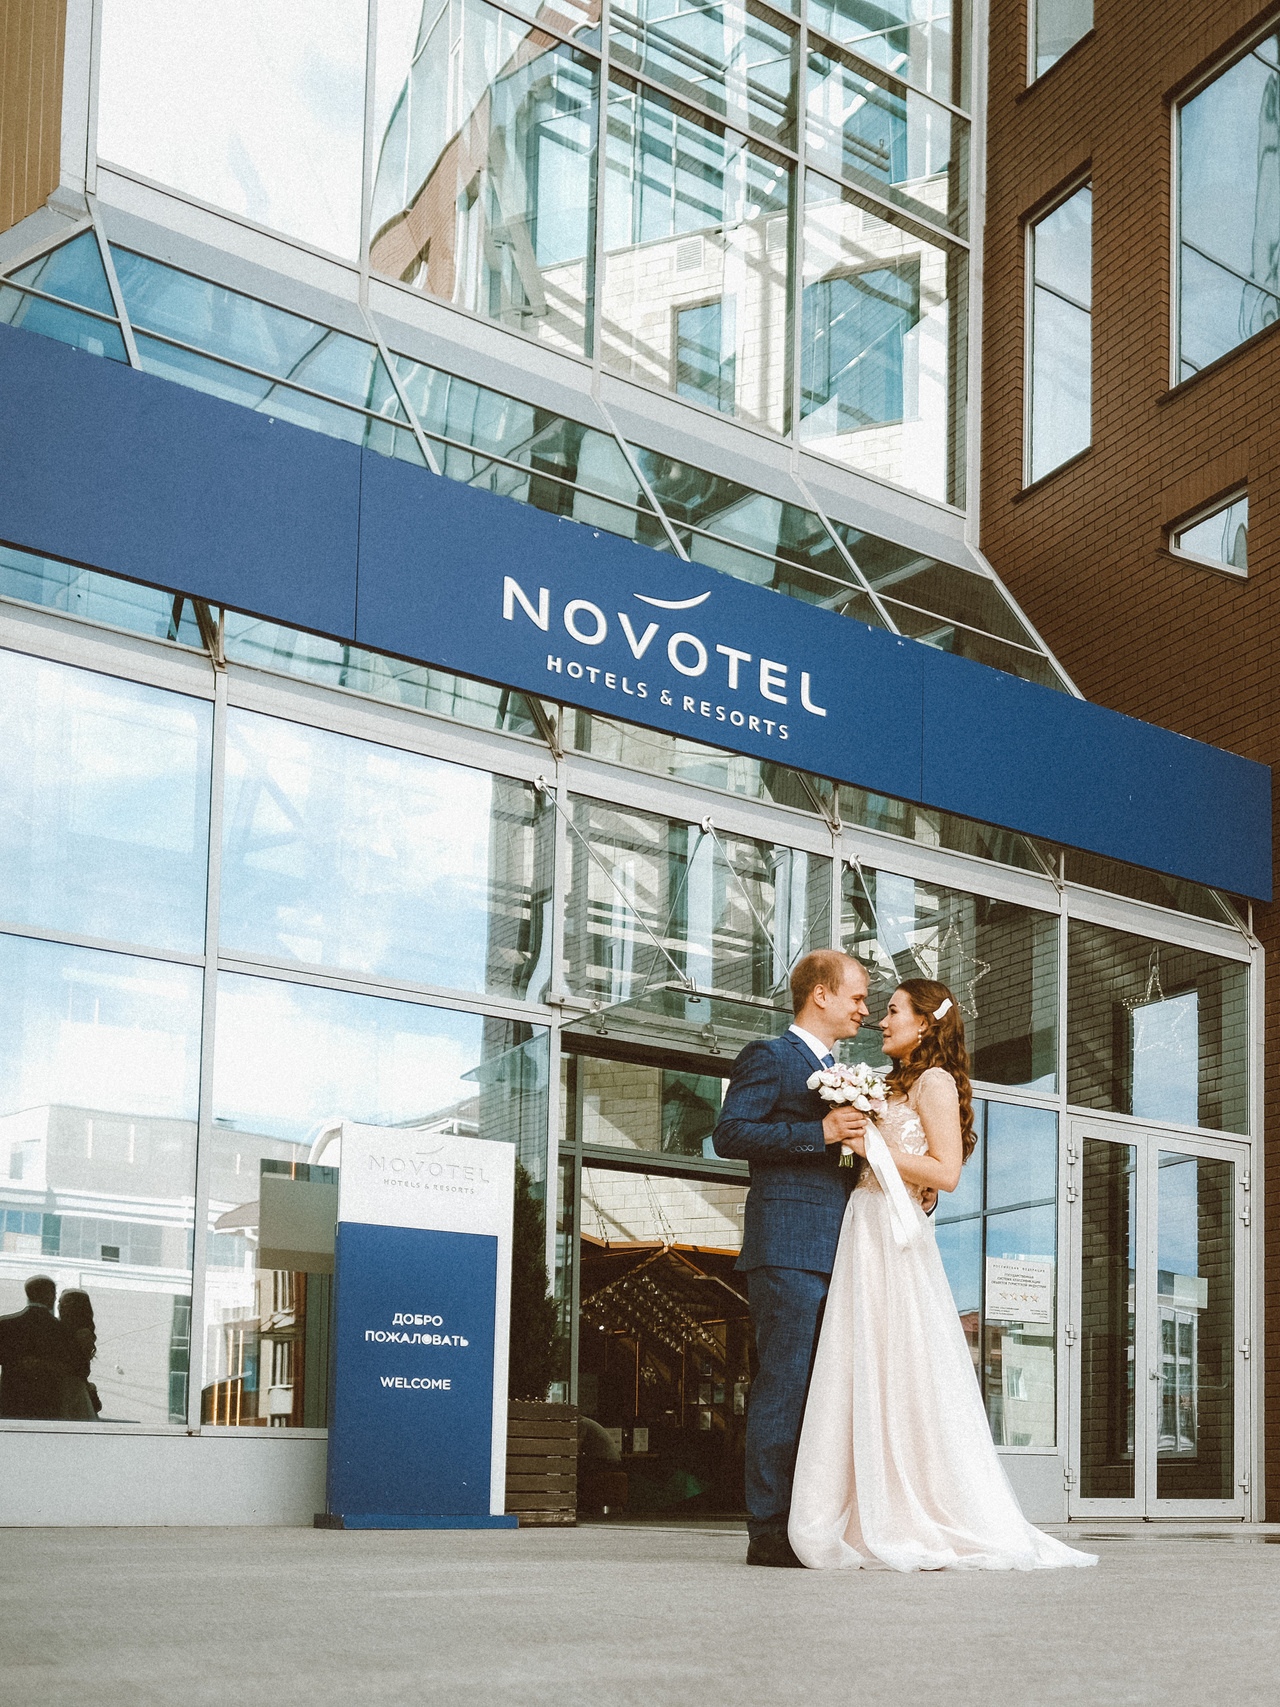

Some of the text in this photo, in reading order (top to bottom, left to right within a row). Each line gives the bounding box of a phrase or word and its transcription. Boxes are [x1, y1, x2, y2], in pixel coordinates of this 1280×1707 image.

[503, 575, 827, 717] NOVOTEL
[546, 654, 789, 740] HOTELS & RESORTS
[369, 1155, 490, 1184] NOVOTEL
[384, 1179, 421, 1189] HOTELS
[433, 1184, 475, 1195] RESORTS
[392, 1313, 444, 1327] ДОБРО
[365, 1330, 469, 1347] ПОЖАЛОВАТЬ
[380, 1376, 451, 1390] WELCOME
